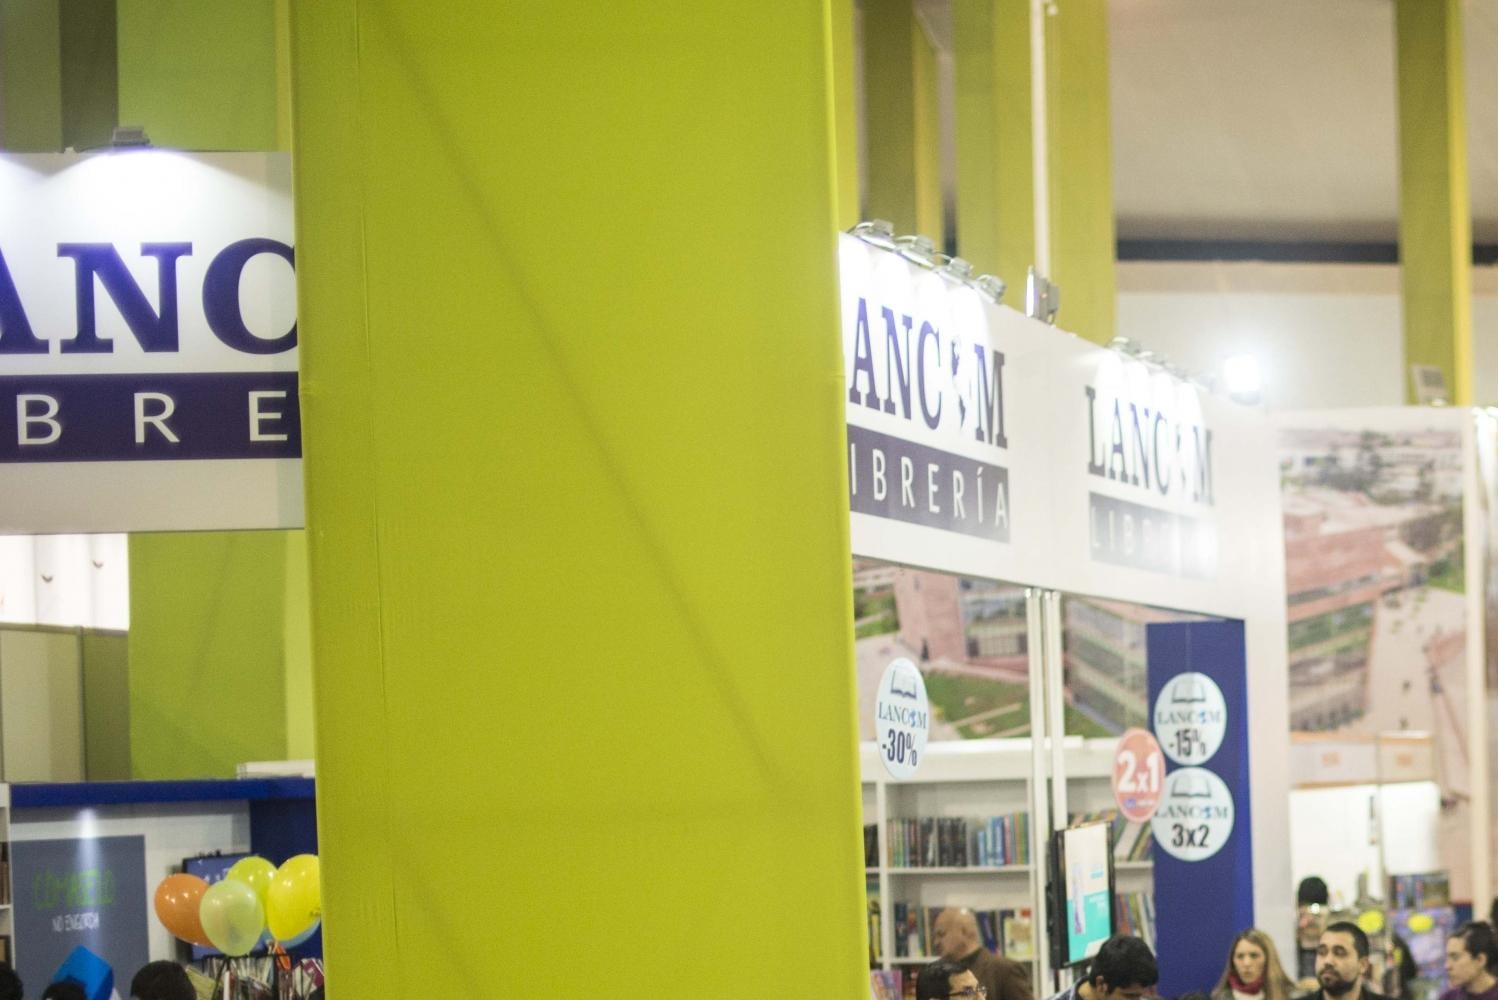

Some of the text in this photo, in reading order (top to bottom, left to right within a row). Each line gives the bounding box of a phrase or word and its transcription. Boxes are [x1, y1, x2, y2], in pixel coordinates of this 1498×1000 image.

[882, 728, 918, 767] -30%
[1117, 750, 1160, 793] 2x1
[1172, 823, 1210, 848] 3x2
